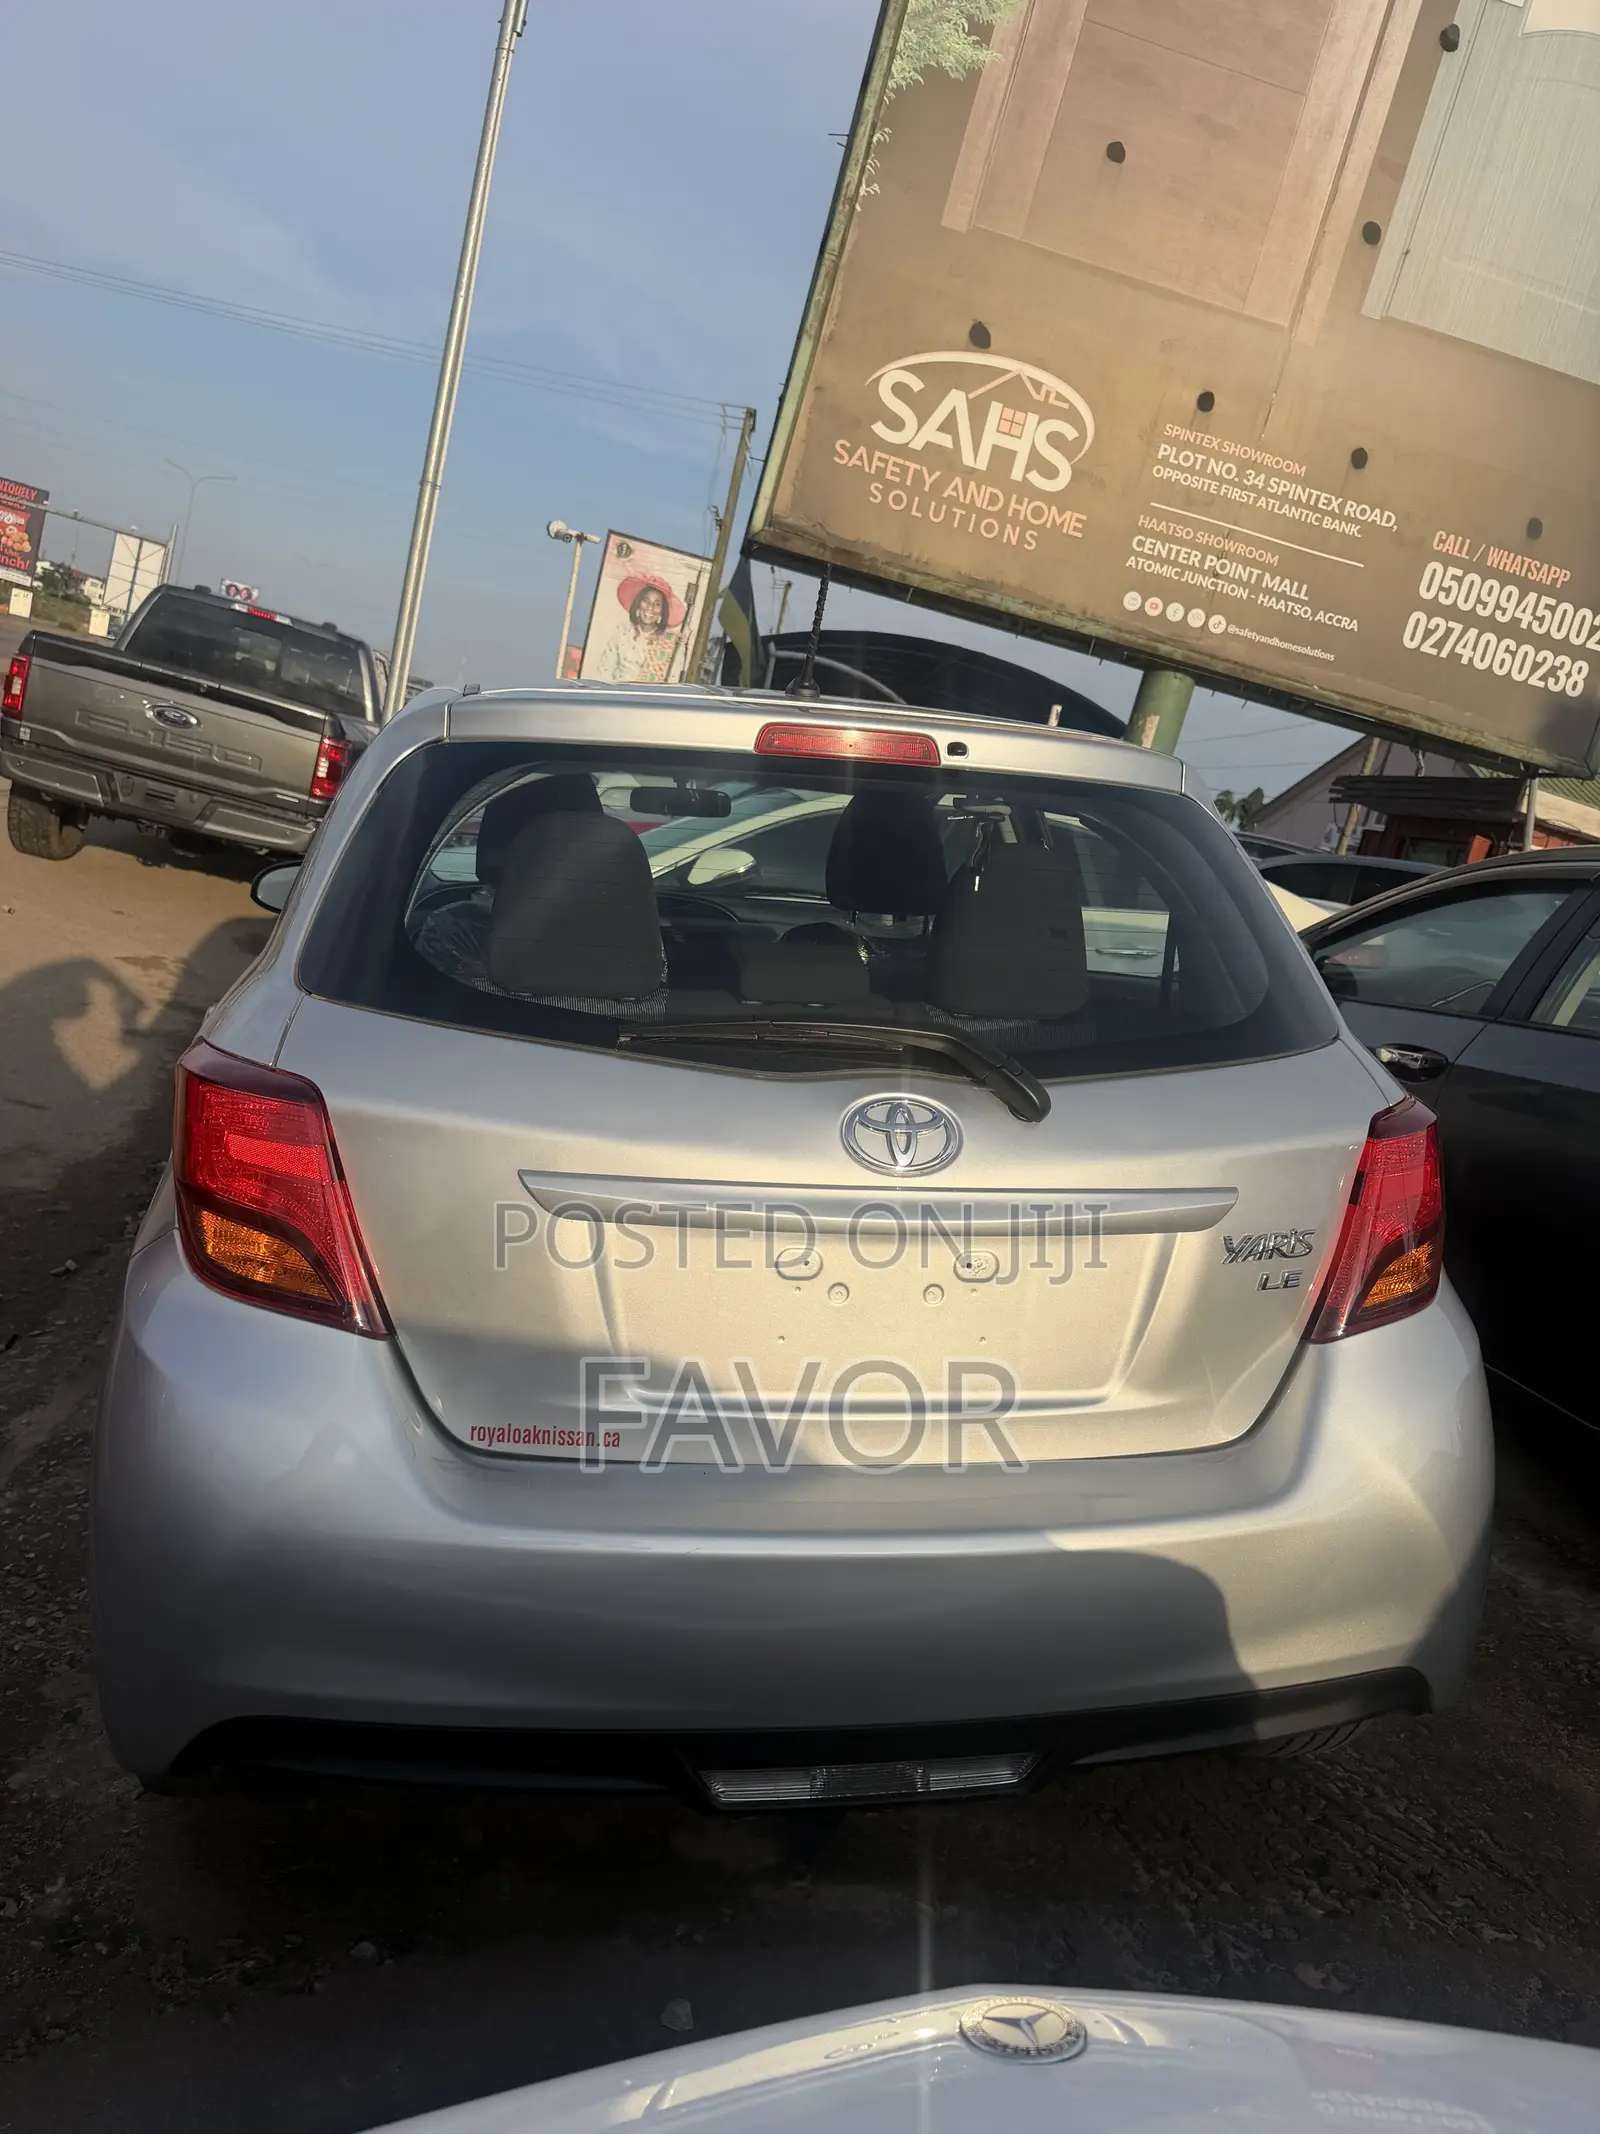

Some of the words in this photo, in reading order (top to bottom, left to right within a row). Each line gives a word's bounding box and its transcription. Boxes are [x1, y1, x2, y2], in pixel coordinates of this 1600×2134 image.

[871, 369, 1079, 492] SAHS
[1163, 423, 1221, 451] SPINTEX
[1221, 440, 1307, 477] SHOWROOM
[833, 439, 941, 492] SAFETY
[942, 477, 1004, 512] AND
[1007, 493, 1087, 538] HOME
[868, 482, 1038, 550] SOLUTIONS
[1152, 466, 1219, 495] OPPOSITE
[1220, 484, 1258, 506] FIRST
[1257, 496, 1322, 526] ATLANTIC
[1322, 517, 1362, 538] BANK.
[1157, 443, 1207, 471] PLOT
[1207, 460, 1239, 482] NO.
[1243, 469, 1265, 490] 34
[1267, 477, 1343, 514] SPINTEX
[1344, 502, 1398, 532] ROAD,
[1132, 535, 1202, 567] CENTER
[1203, 554, 1262, 586] POINT
[1262, 572, 1309, 601] MALL
[1138, 514, 1194, 541] HAATSO
[1196, 531, 1279, 567] SHOWROOM
[1432, 530, 1471, 560] CALL
[1473, 543, 1486, 562] /
[1486, 545, 1571, 588] WHATSAPP
[1126, 555, 1183, 583] ATOMIC
[1181, 568, 1249, 600] JUNCTION
[1257, 593, 1313, 622] HAATSO,
[1315, 609, 1359, 632] ACCRA
[1419, 561, 1600, 651] 0509945002
[1227, 624, 1335, 661] @safetyandhomesolutions
[1402, 611, 1590, 697] 0274060238
[1255, 1269, 1304, 1292] LE
[470, 1423, 621, 1448] royaloaknissan.ca
